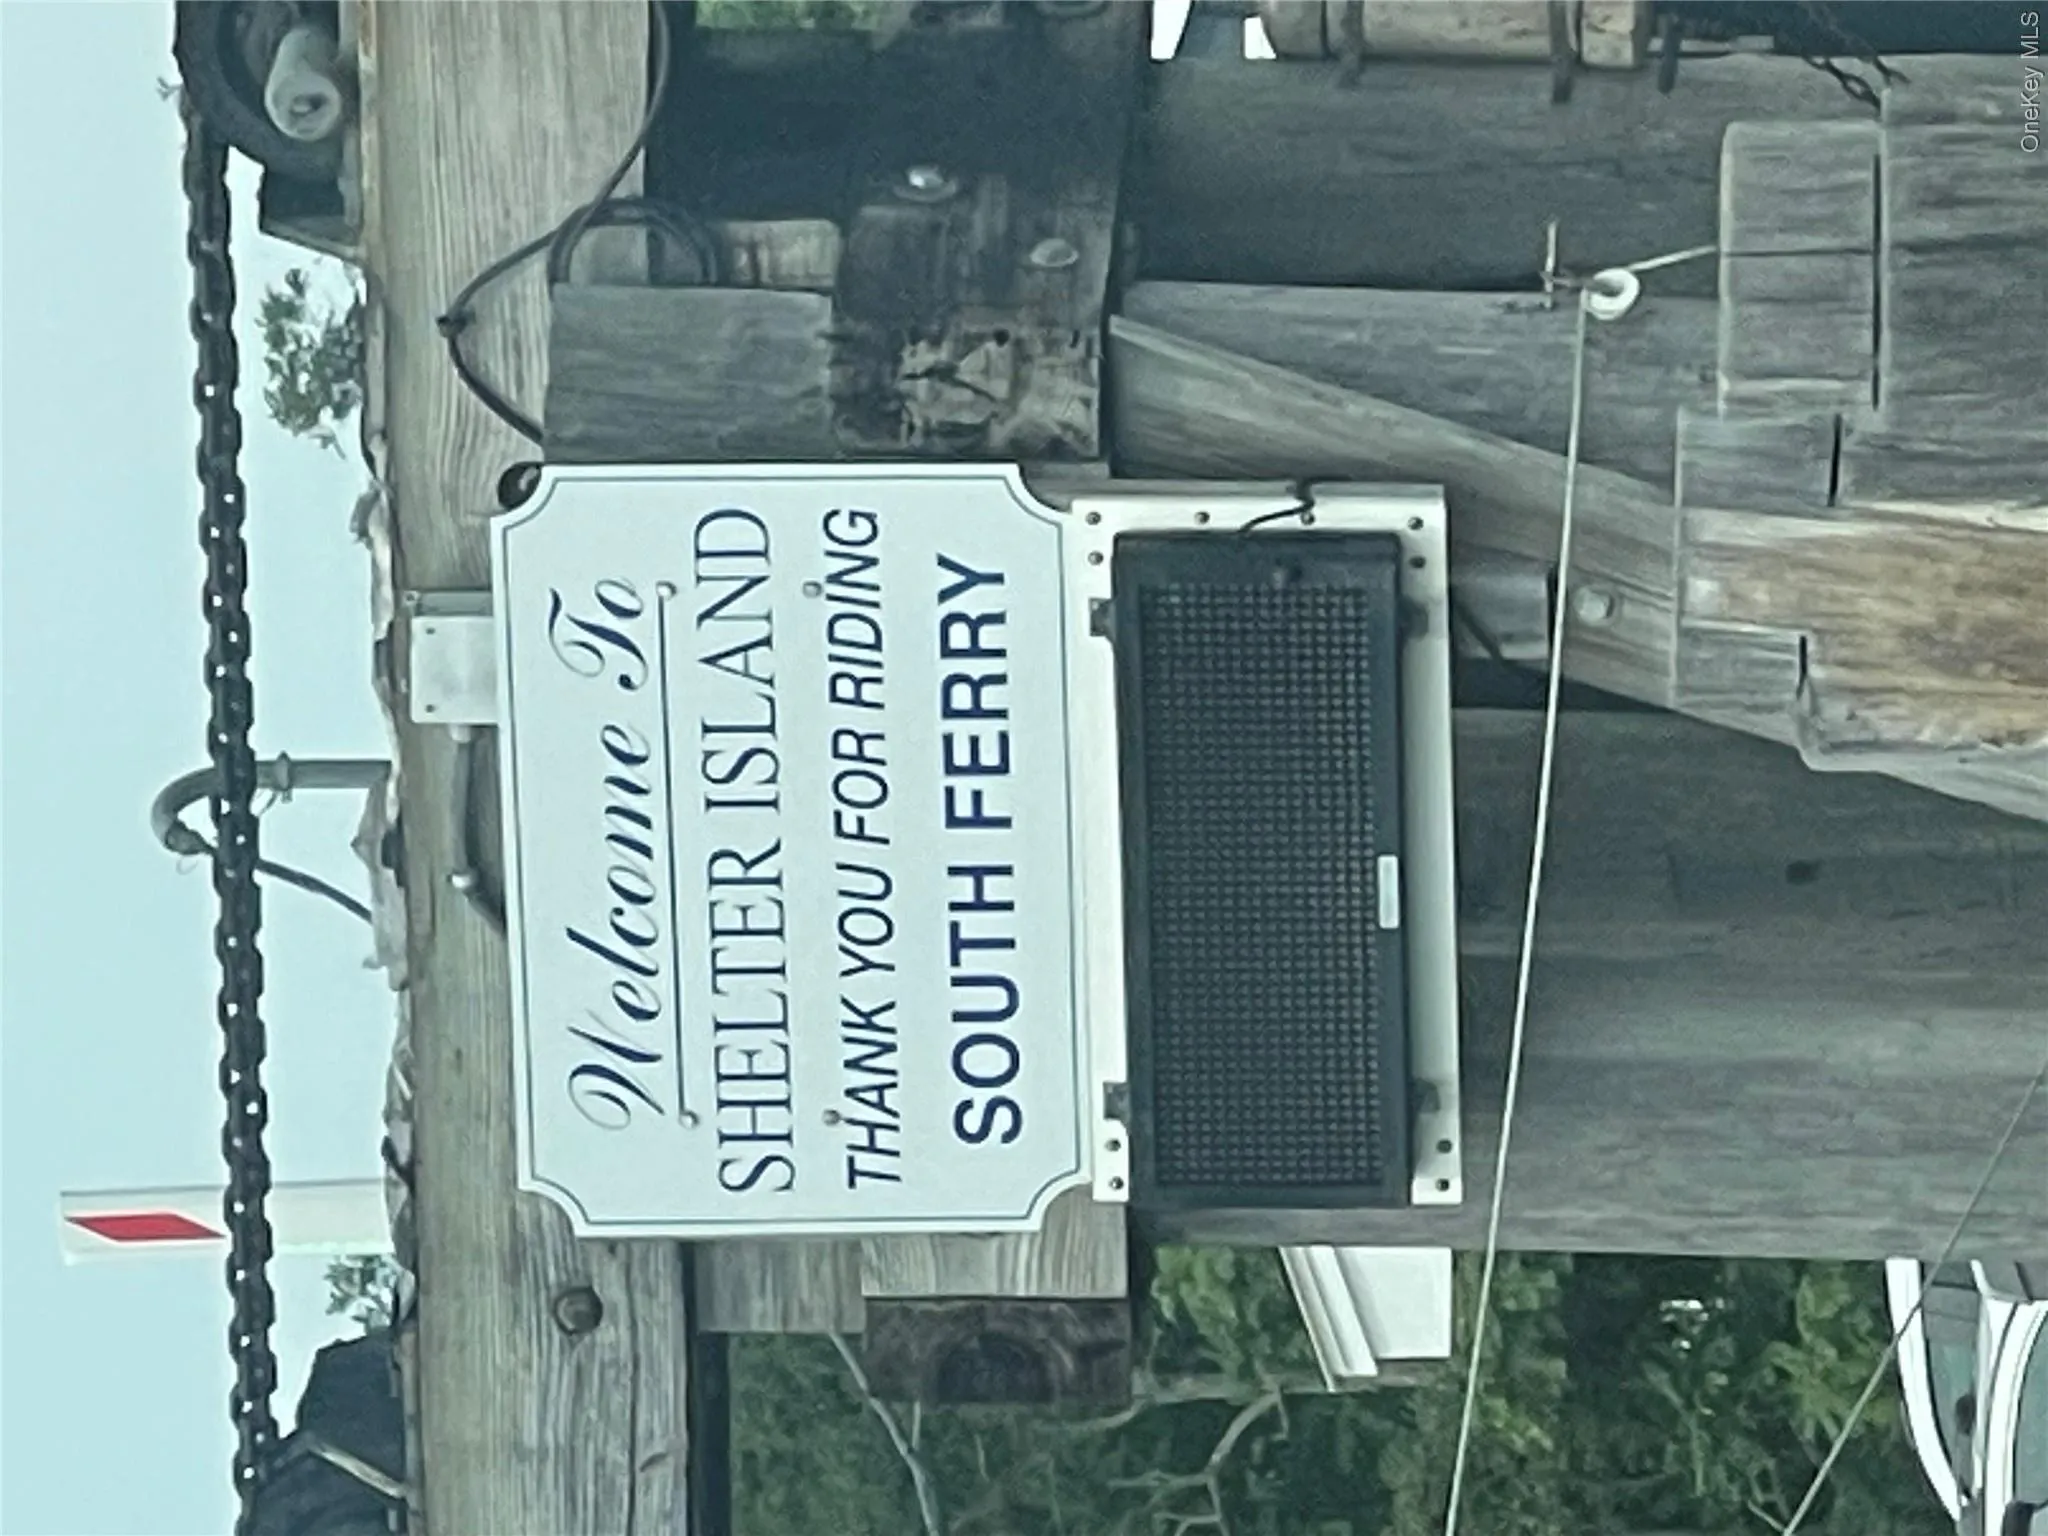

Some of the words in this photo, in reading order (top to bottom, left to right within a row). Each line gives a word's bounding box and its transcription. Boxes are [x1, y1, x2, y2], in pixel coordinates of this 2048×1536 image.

[547, 577, 644, 692] To
[693, 509, 781, 812] ISLAND
[822, 509, 885, 710] RIDING
[936, 553, 1013, 830] FERRY
[831, 728, 891, 846] FOR
[565, 724, 666, 1131] Welcome
[707, 837, 796, 1192] SHELTER
[835, 862, 897, 978] YOU
[946, 864, 1023, 1144] SOUTH
[840, 995, 902, 1190] THANK
